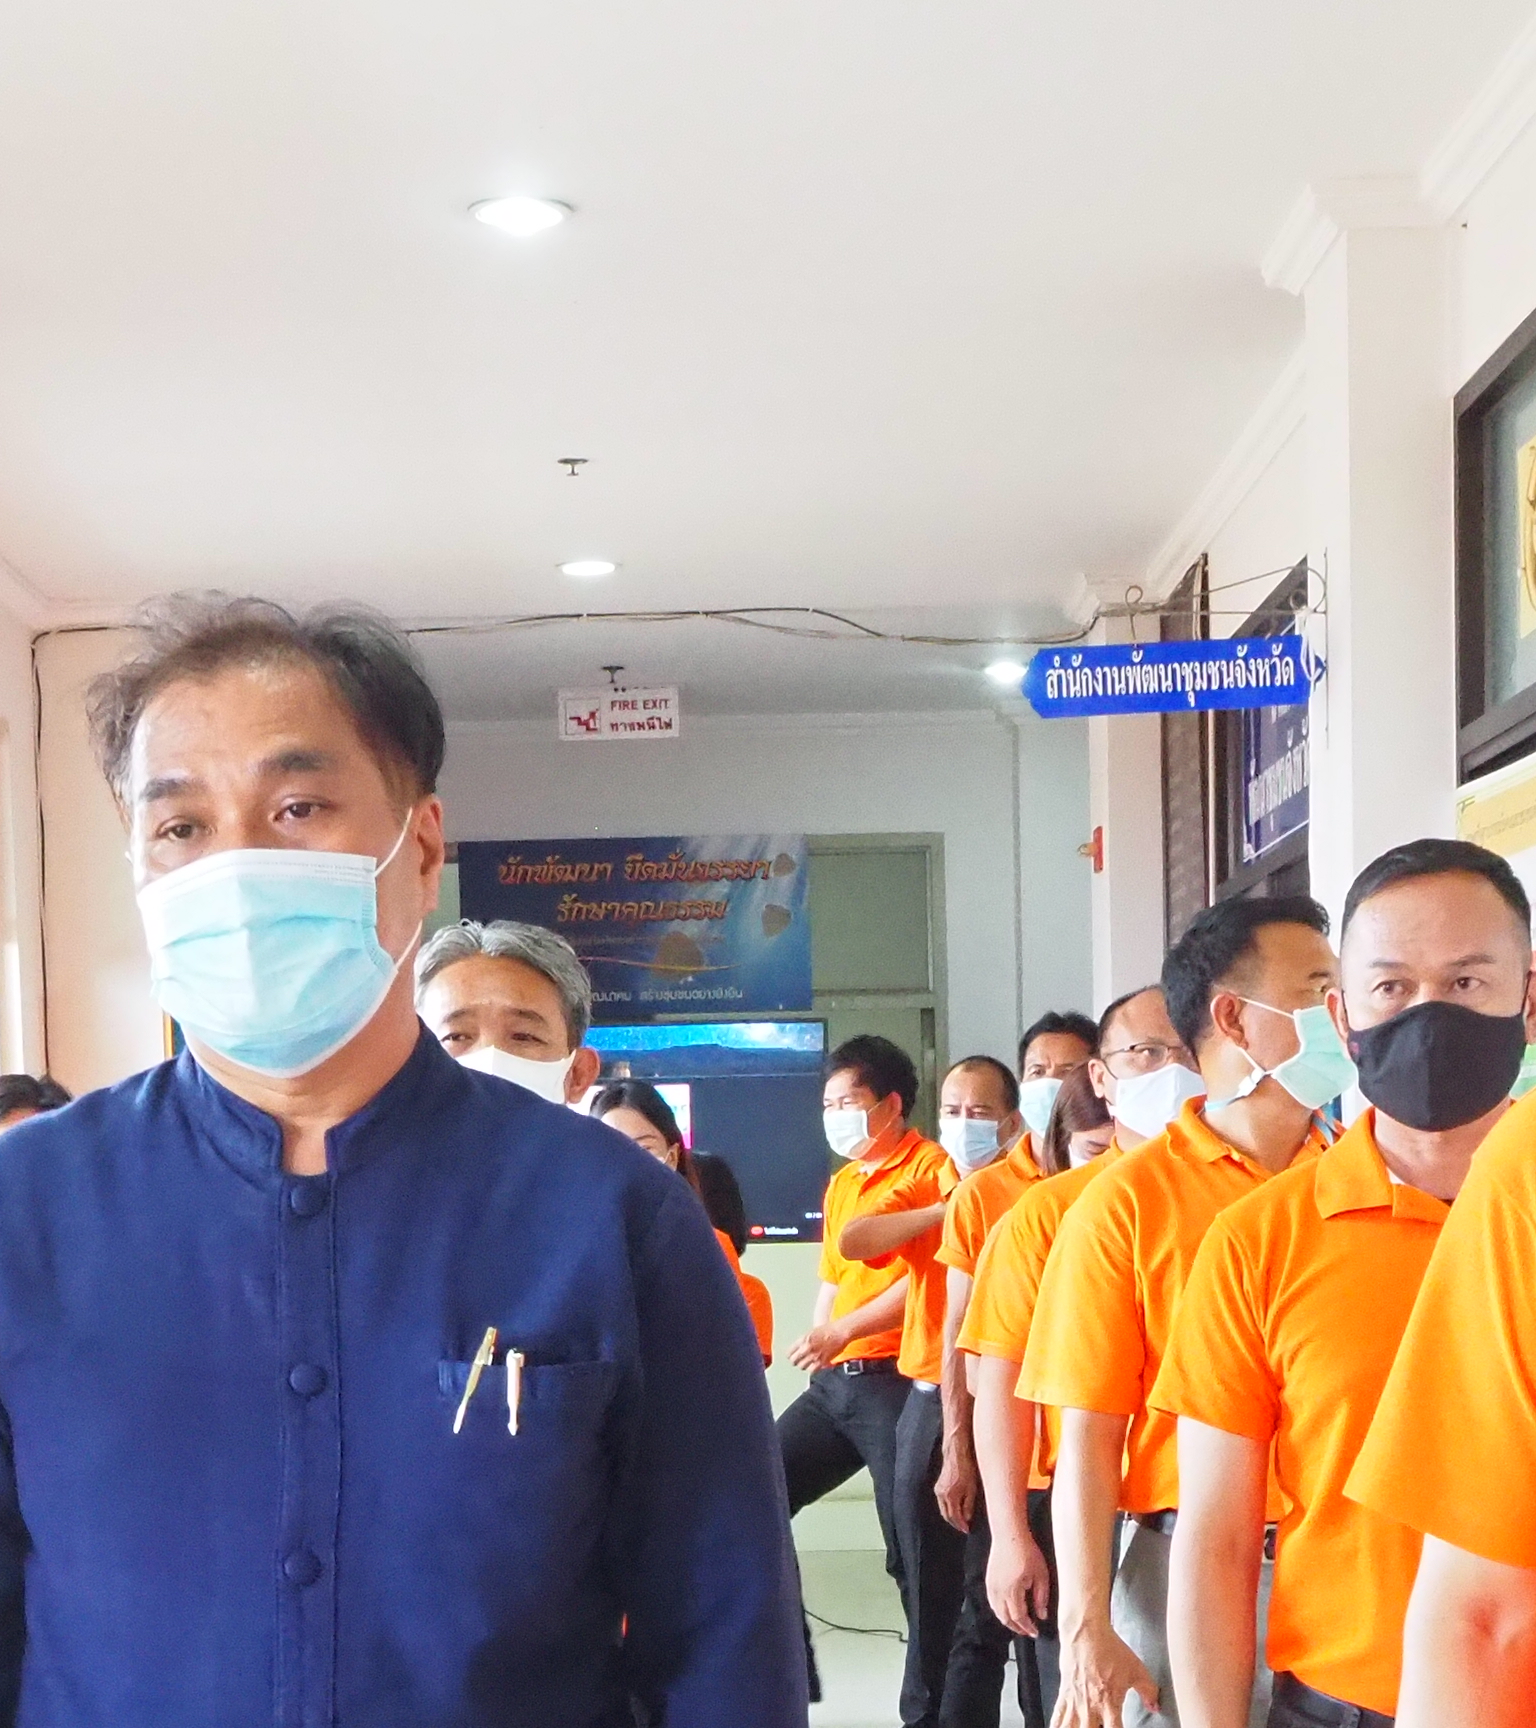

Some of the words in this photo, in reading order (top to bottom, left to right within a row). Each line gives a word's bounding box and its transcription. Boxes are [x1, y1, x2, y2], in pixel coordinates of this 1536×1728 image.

[1046, 643, 1294, 706] สำนักงานพัฒนาชุมชนจังหวัด
[611, 699, 638, 711] FIRE
[643, 698, 670, 710] EXIT
